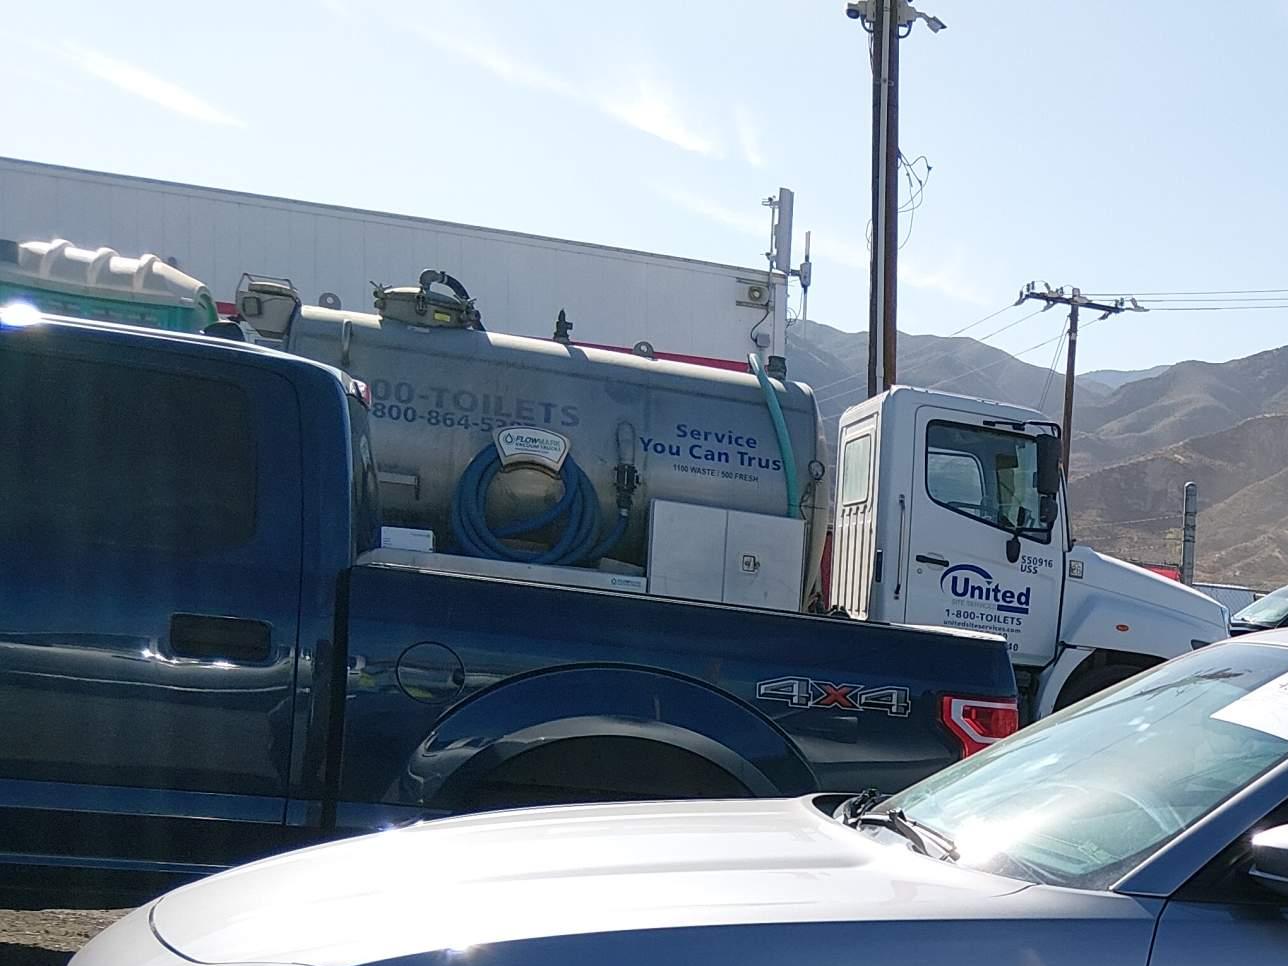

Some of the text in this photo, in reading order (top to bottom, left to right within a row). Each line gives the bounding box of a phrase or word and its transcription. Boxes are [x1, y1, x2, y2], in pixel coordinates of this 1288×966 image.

[676, 424, 757, 449] Service
[640, 436, 783, 471] You Can Trus
[673, 464, 689, 473] 1100
[690, 465, 715, 477] WASTE
[721, 470, 733, 480] 500
[734, 472, 759, 483] FRESH
[1020, 564, 1038, 575] USS
[951, 575, 1031, 607] United
[945, 608, 1022, 626] 1-800-TOILETS
